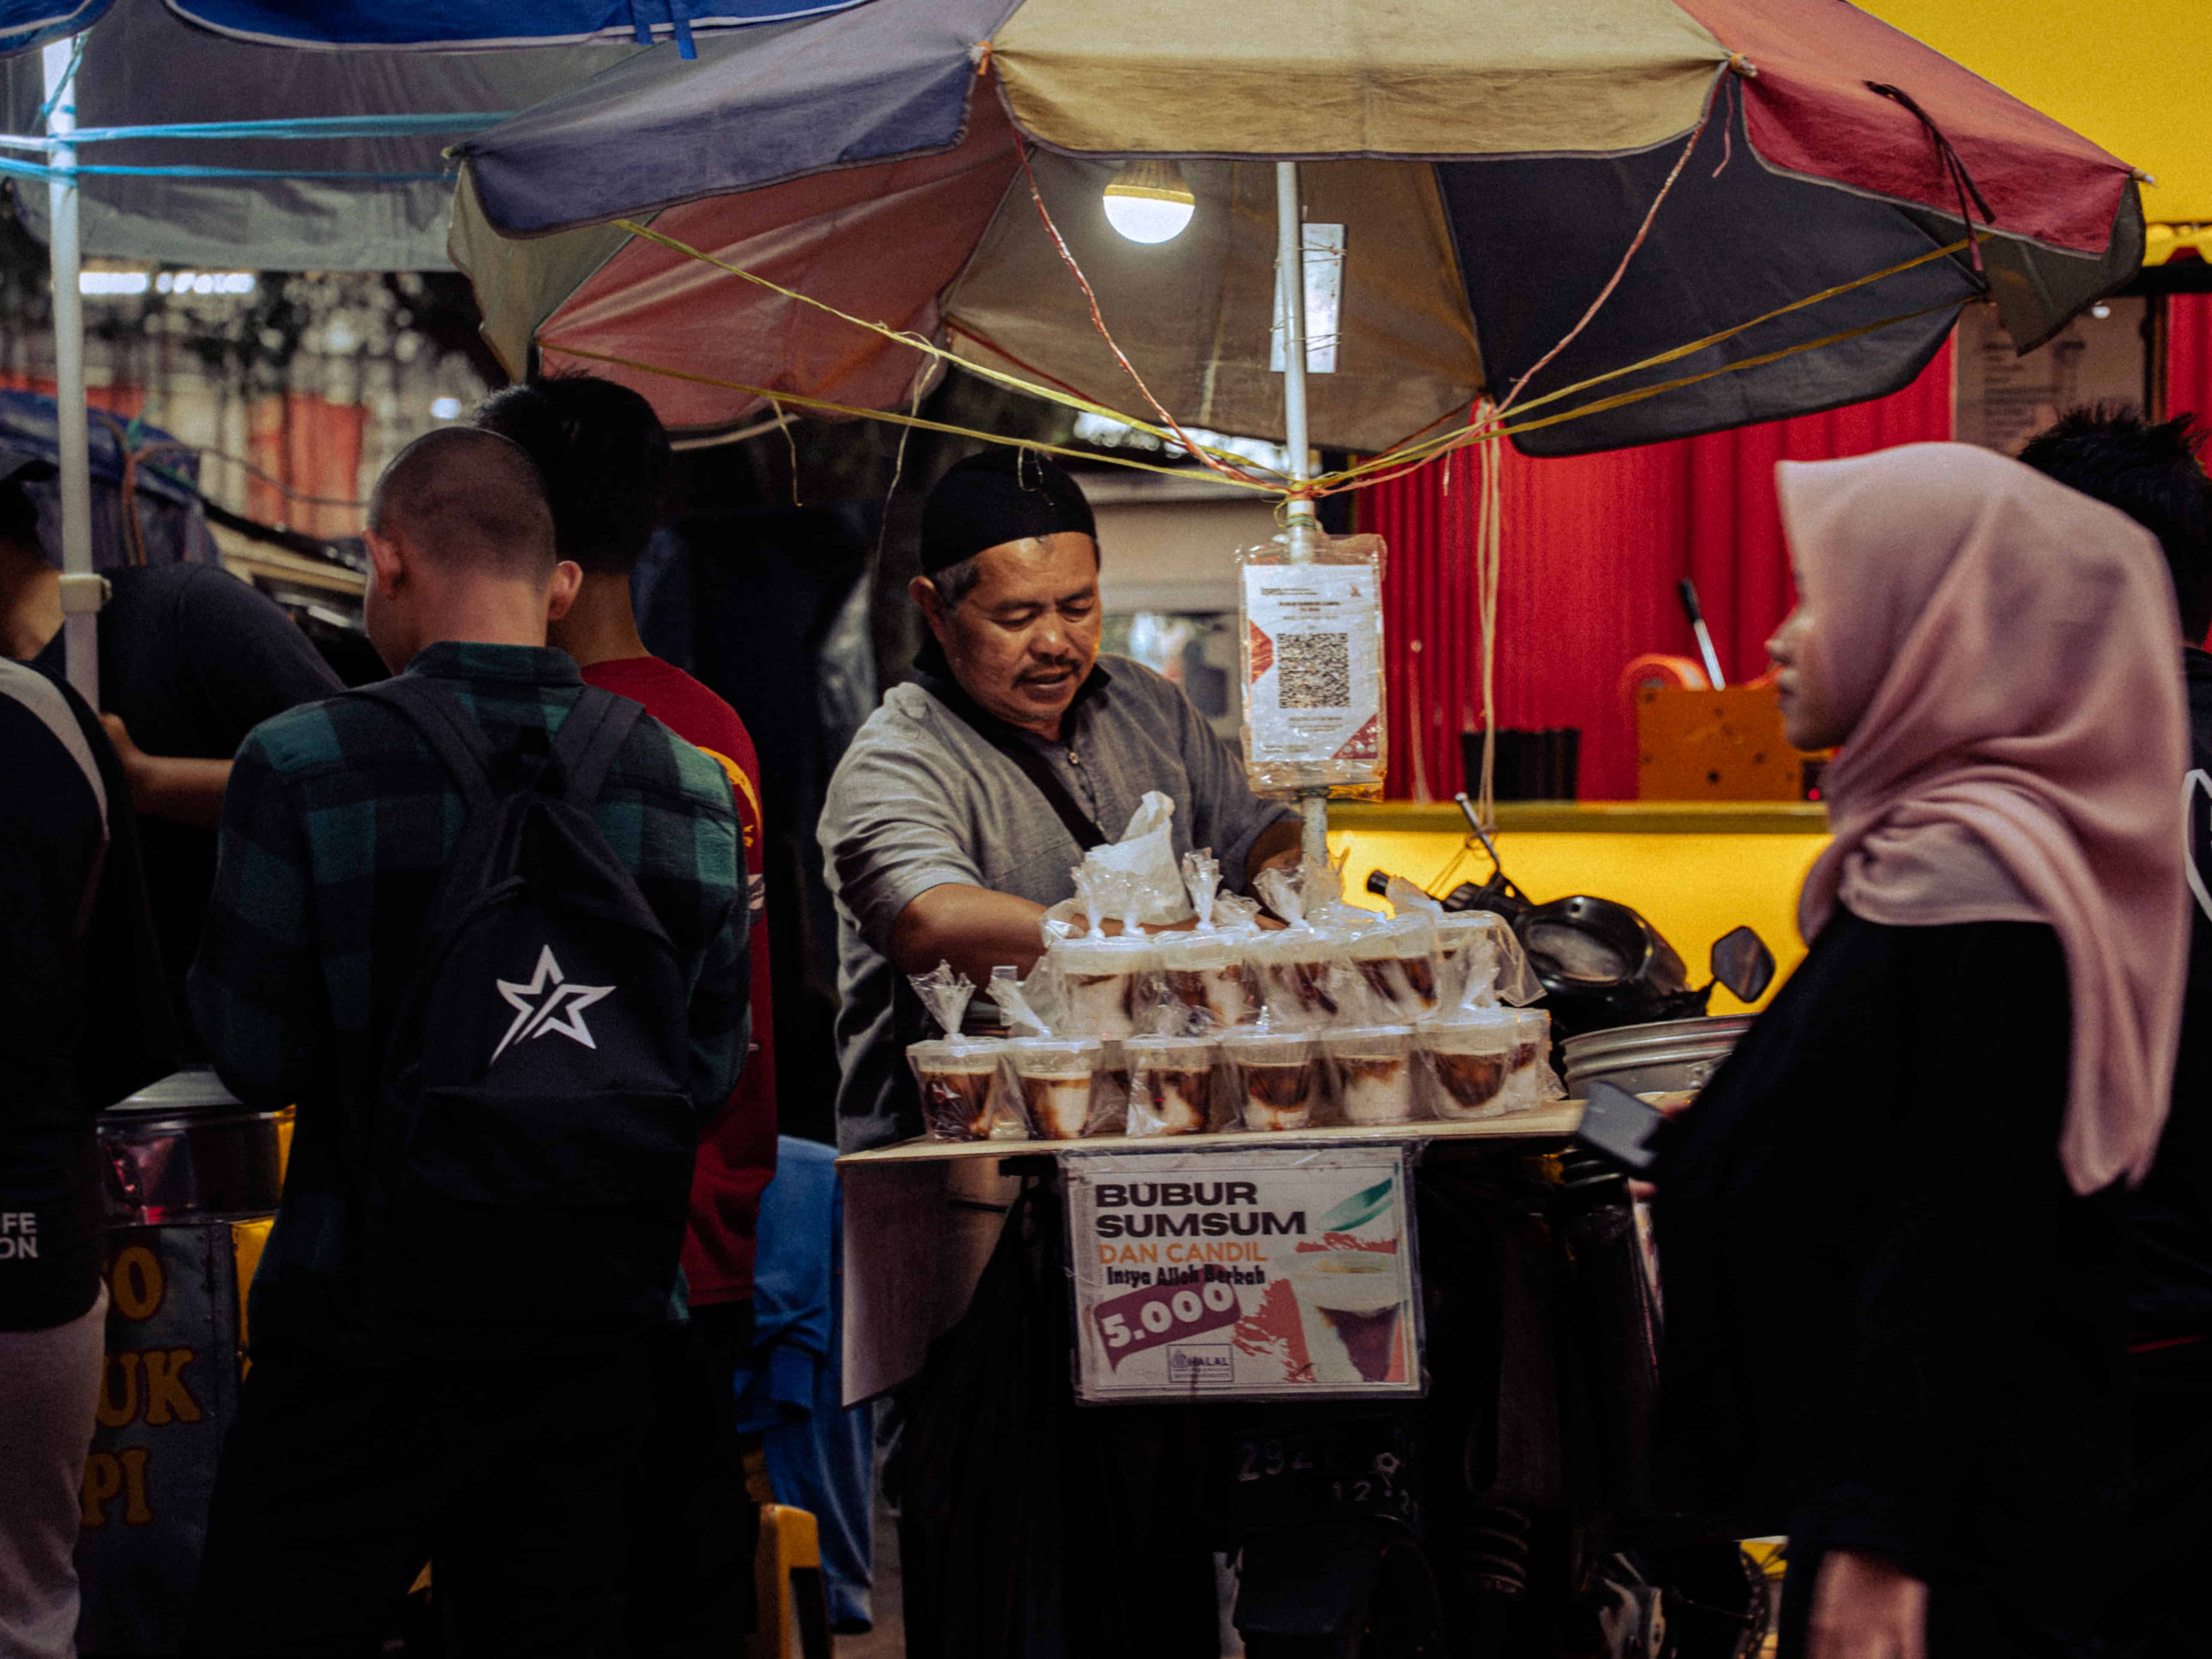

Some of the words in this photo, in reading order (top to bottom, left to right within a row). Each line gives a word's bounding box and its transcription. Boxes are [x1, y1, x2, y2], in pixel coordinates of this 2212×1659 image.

[1095, 1182, 1258, 1207] BUBUR
[1096, 1211, 1306, 1238] SUMSUM
[1098, 1243, 1158, 1264] DAN
[1166, 1242, 1270, 1262] CANDIL
[104, 1246, 163, 1319] O
[1107, 1266, 1151, 1288] Insya
[1203, 1264, 1265, 1285] Berkah
[1101, 1281, 1234, 1347] 5.000
